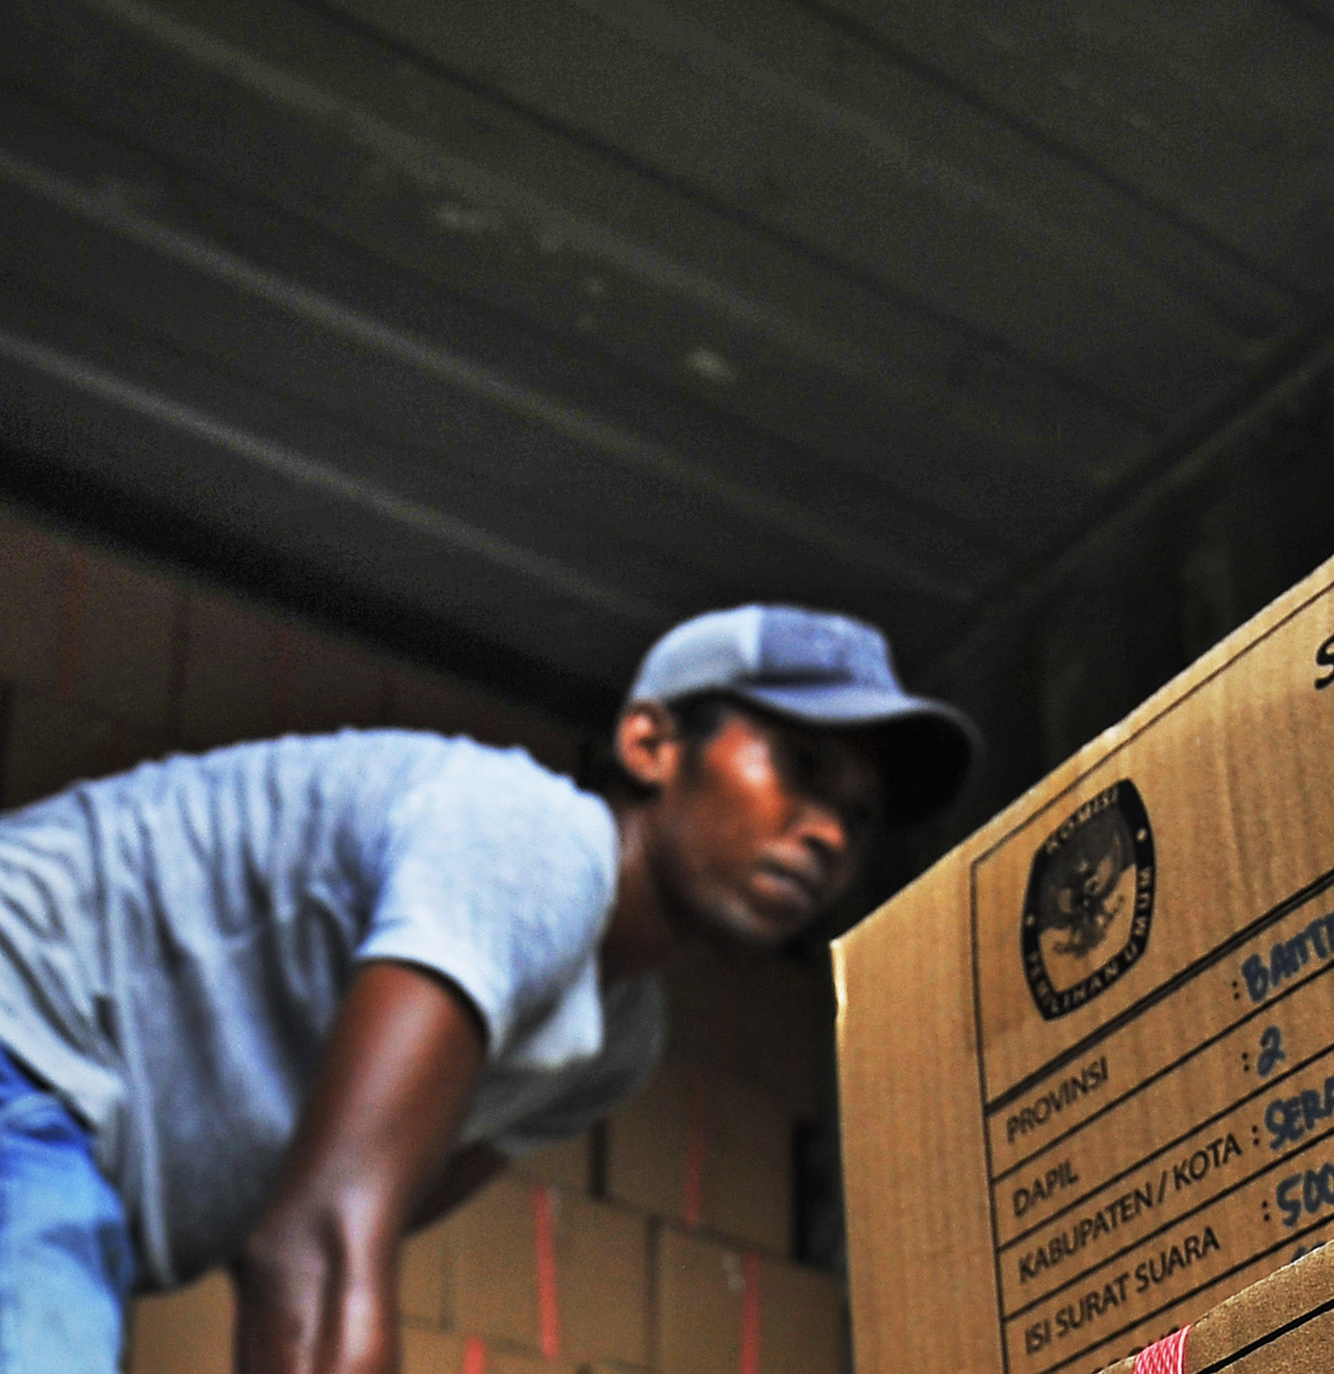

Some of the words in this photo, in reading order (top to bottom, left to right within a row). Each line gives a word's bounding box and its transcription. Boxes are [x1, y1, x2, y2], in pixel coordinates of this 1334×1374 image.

[1257, 1025, 1285, 1077] 2
[1006, 1056, 1109, 1144] PROVINSI
[1013, 1160, 1078, 1220] DAPIL
[1173, 1133, 1242, 1192] KOTA
[1024, 1322, 1051, 1355] ISI
[1056, 1271, 1129, 1339] SURAT
[1136, 1226, 1220, 1293] SUARA
